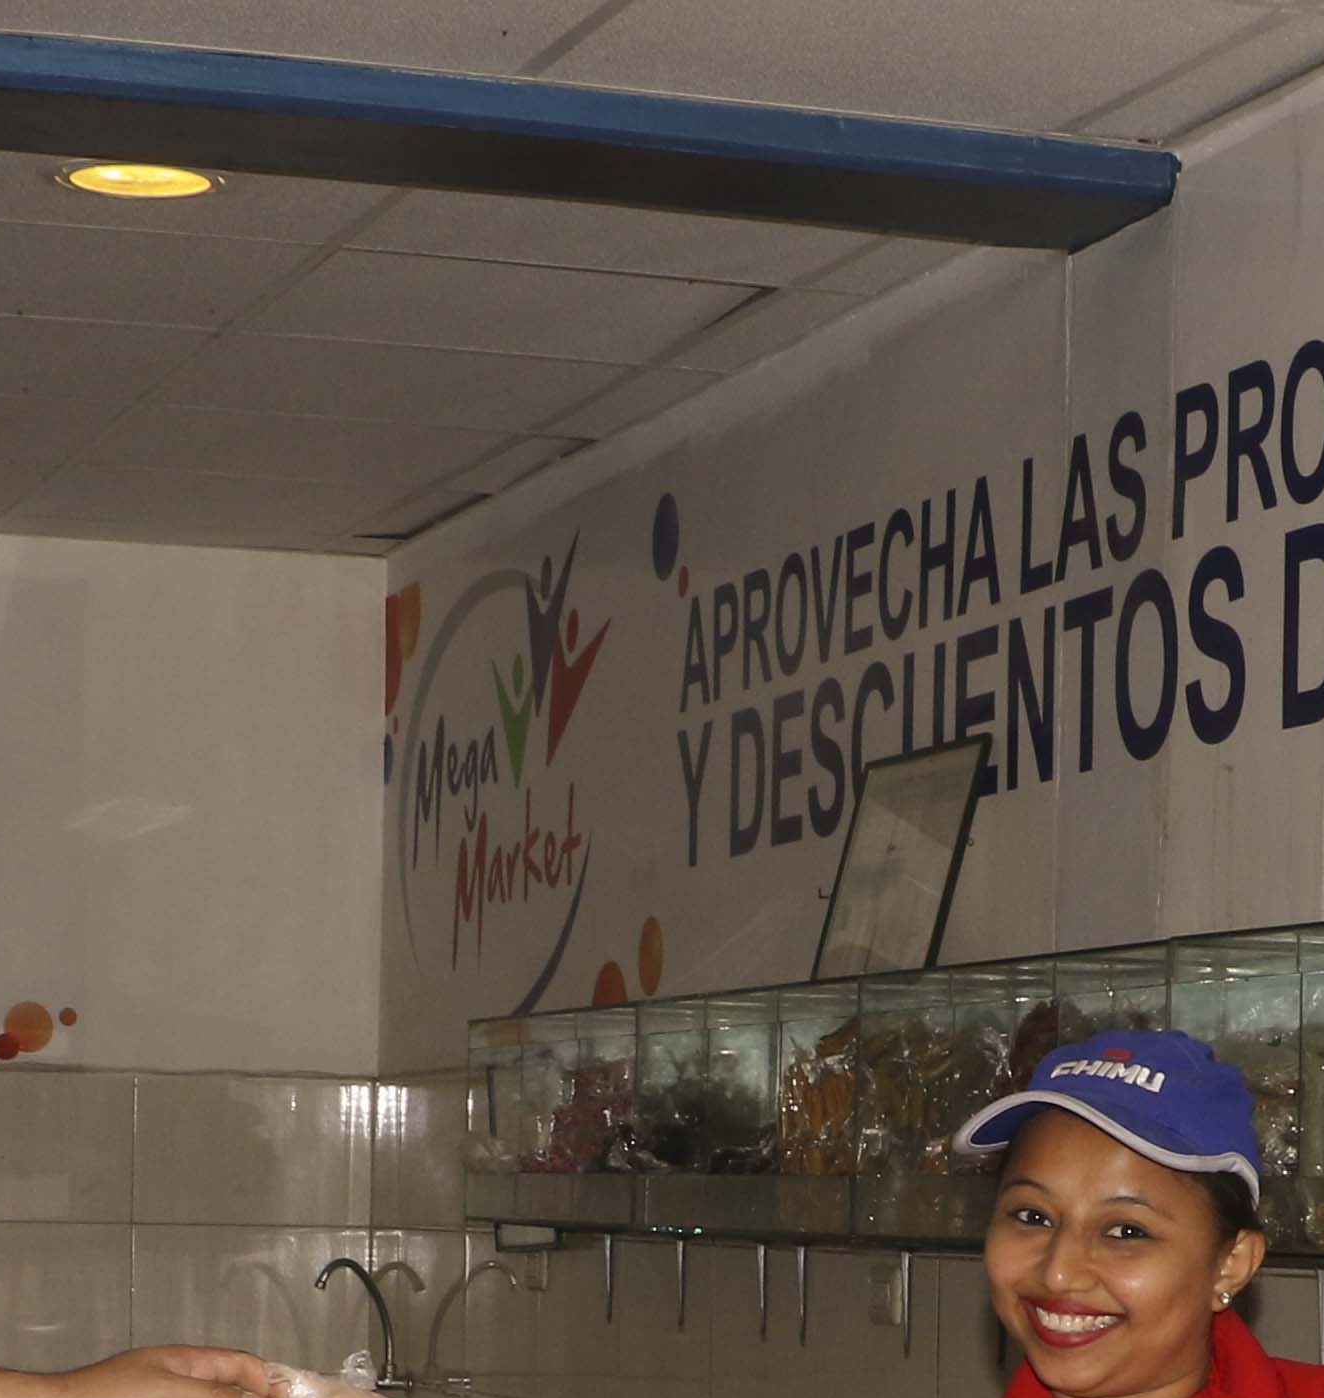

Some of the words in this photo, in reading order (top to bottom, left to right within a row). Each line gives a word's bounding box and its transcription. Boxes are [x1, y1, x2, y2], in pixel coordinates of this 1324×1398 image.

[679, 474, 1002, 715] APROVECHA
[1019, 409, 1148, 597] LAS
[412, 714, 499, 872] Mega
[676, 719, 713, 868] Y
[728, 544, 1247, 860] DESCUENTOS
[452, 781, 583, 974] Market
[1050, 1060, 1166, 1093] CHIMU
